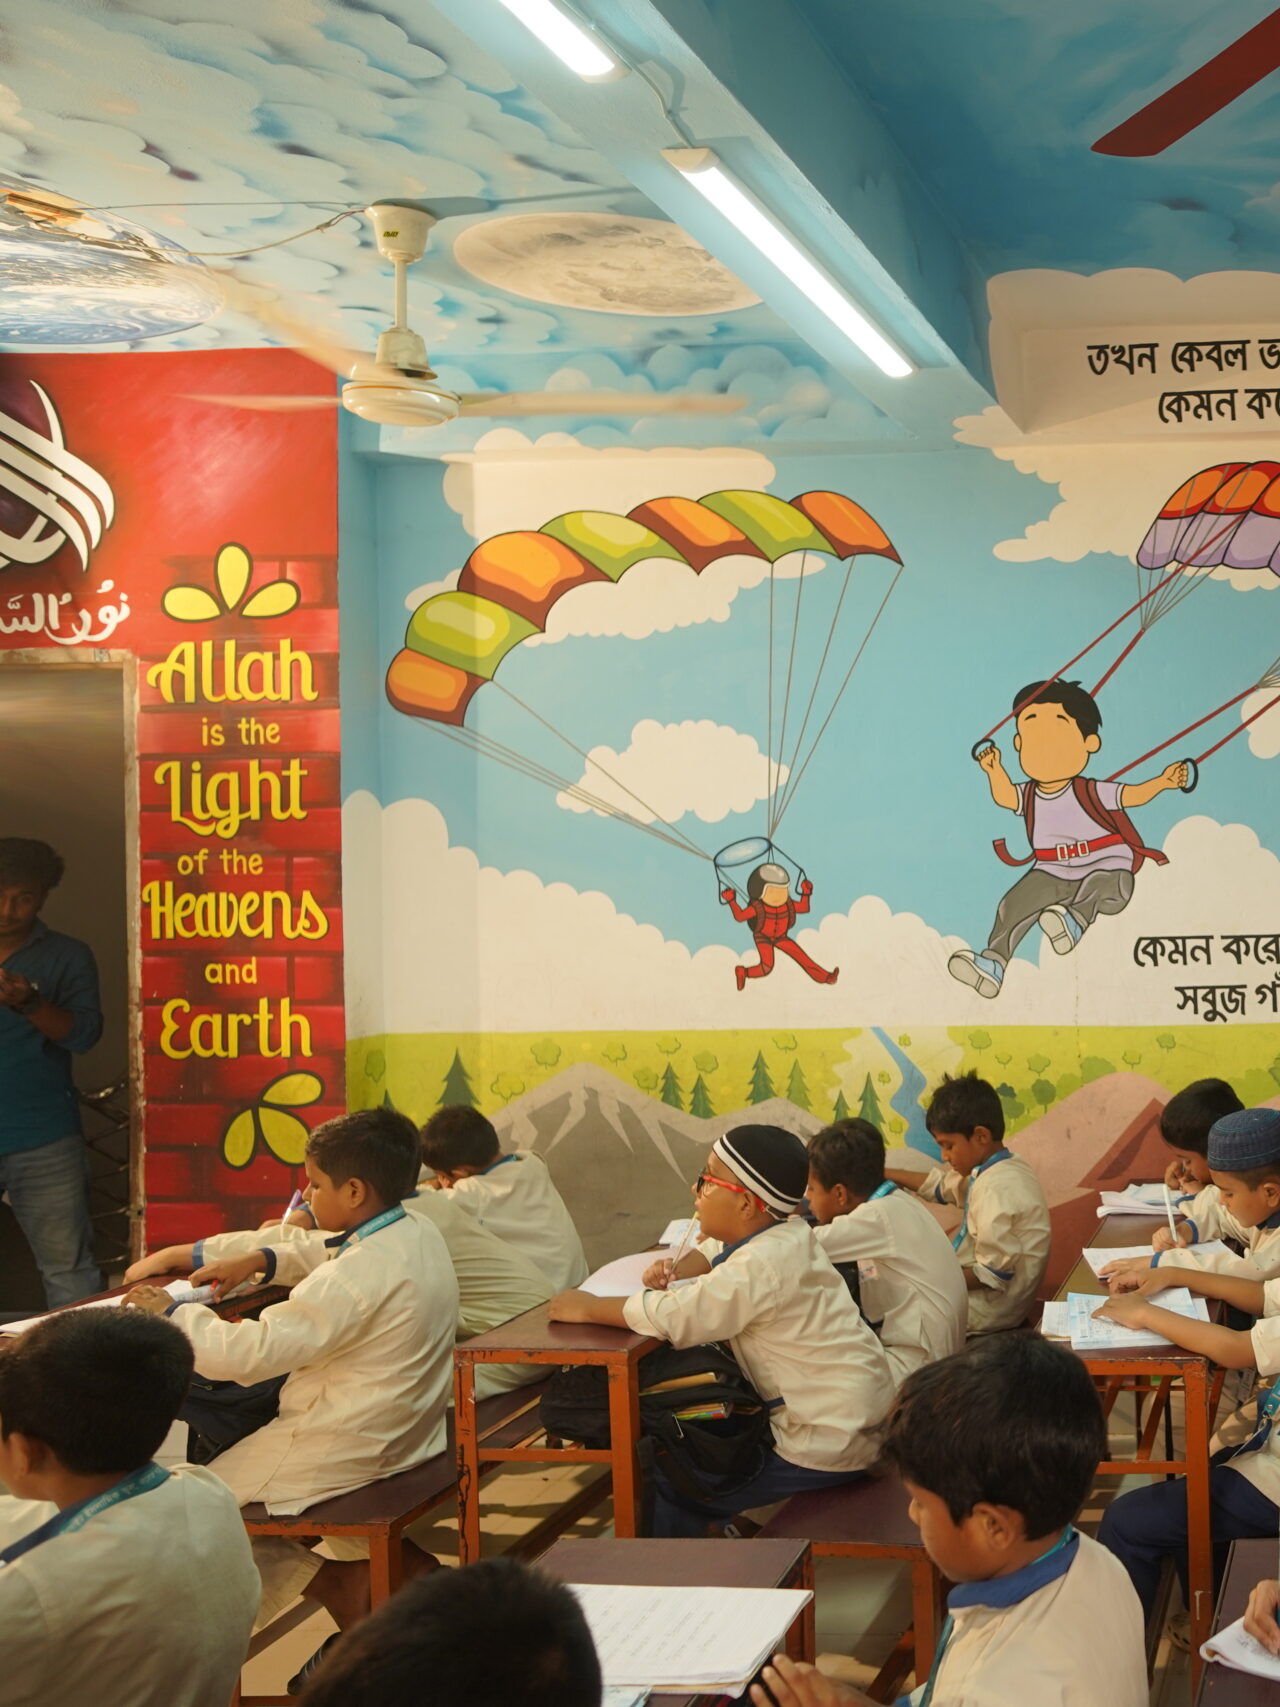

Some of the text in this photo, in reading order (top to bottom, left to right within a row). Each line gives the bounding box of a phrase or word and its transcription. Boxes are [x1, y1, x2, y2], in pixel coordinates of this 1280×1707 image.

[1086, 343, 1159, 375] তখন
[1171, 339, 1251, 373] কেবল
[1158, 389, 1238, 423] কেমন
[146, 638, 318, 704] Allah
[202, 717, 281, 746] is the
[154, 758, 308, 839] Light
[177, 848, 264, 876] of the
[142, 880, 328, 940] Heavens
[1133, 935, 1213, 967] কেমন
[205, 956, 258, 984] and
[1175, 984, 1247, 1022] সবুজ
[160, 997, 313, 1059] Earth
